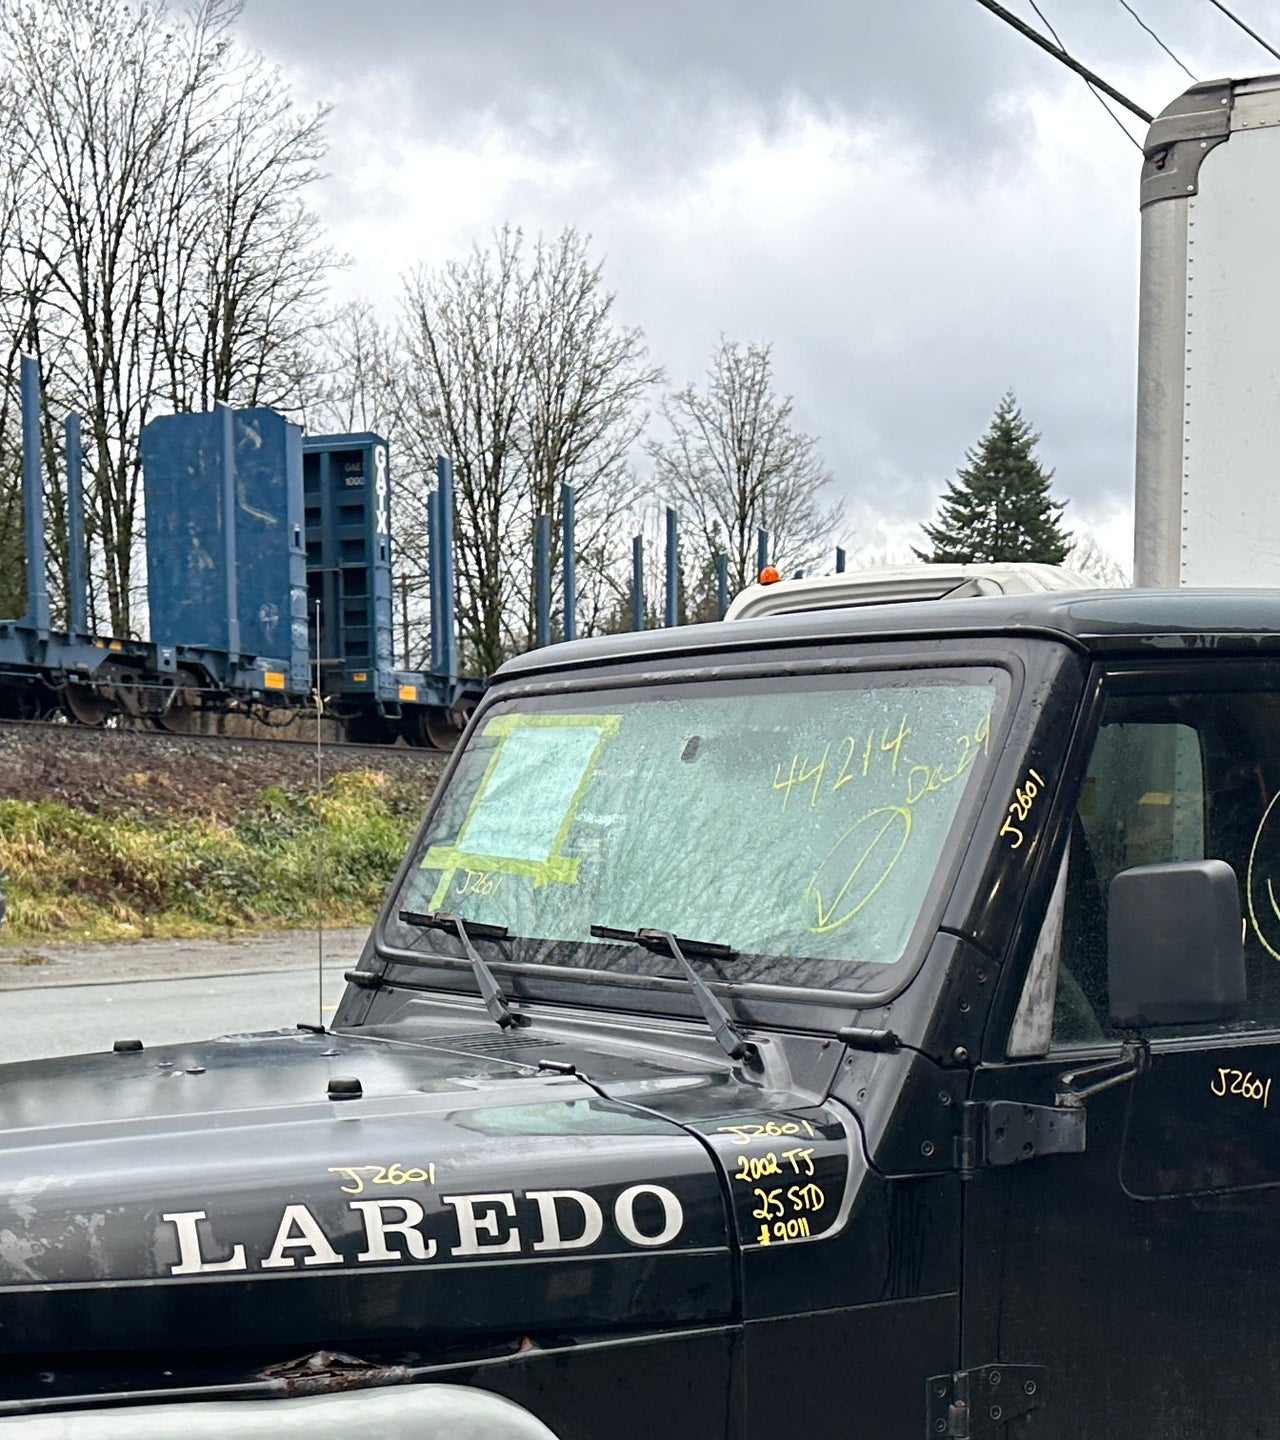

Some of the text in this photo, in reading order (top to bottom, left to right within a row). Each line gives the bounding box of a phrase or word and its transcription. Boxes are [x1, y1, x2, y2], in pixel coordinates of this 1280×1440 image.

[374, 445, 388, 534] GATX
[773, 713, 912, 813] 44214
[1000, 768, 1046, 849] J2601
[1211, 1067, 1272, 1108] J2601
[717, 1119, 815, 1145] J2601
[327, 1162, 437, 1194] J2601
[735, 1147, 815, 1182] 2002 TJ
[787, 1183, 825, 1211] STD
[162, 1184, 686, 1276] LAREDO
